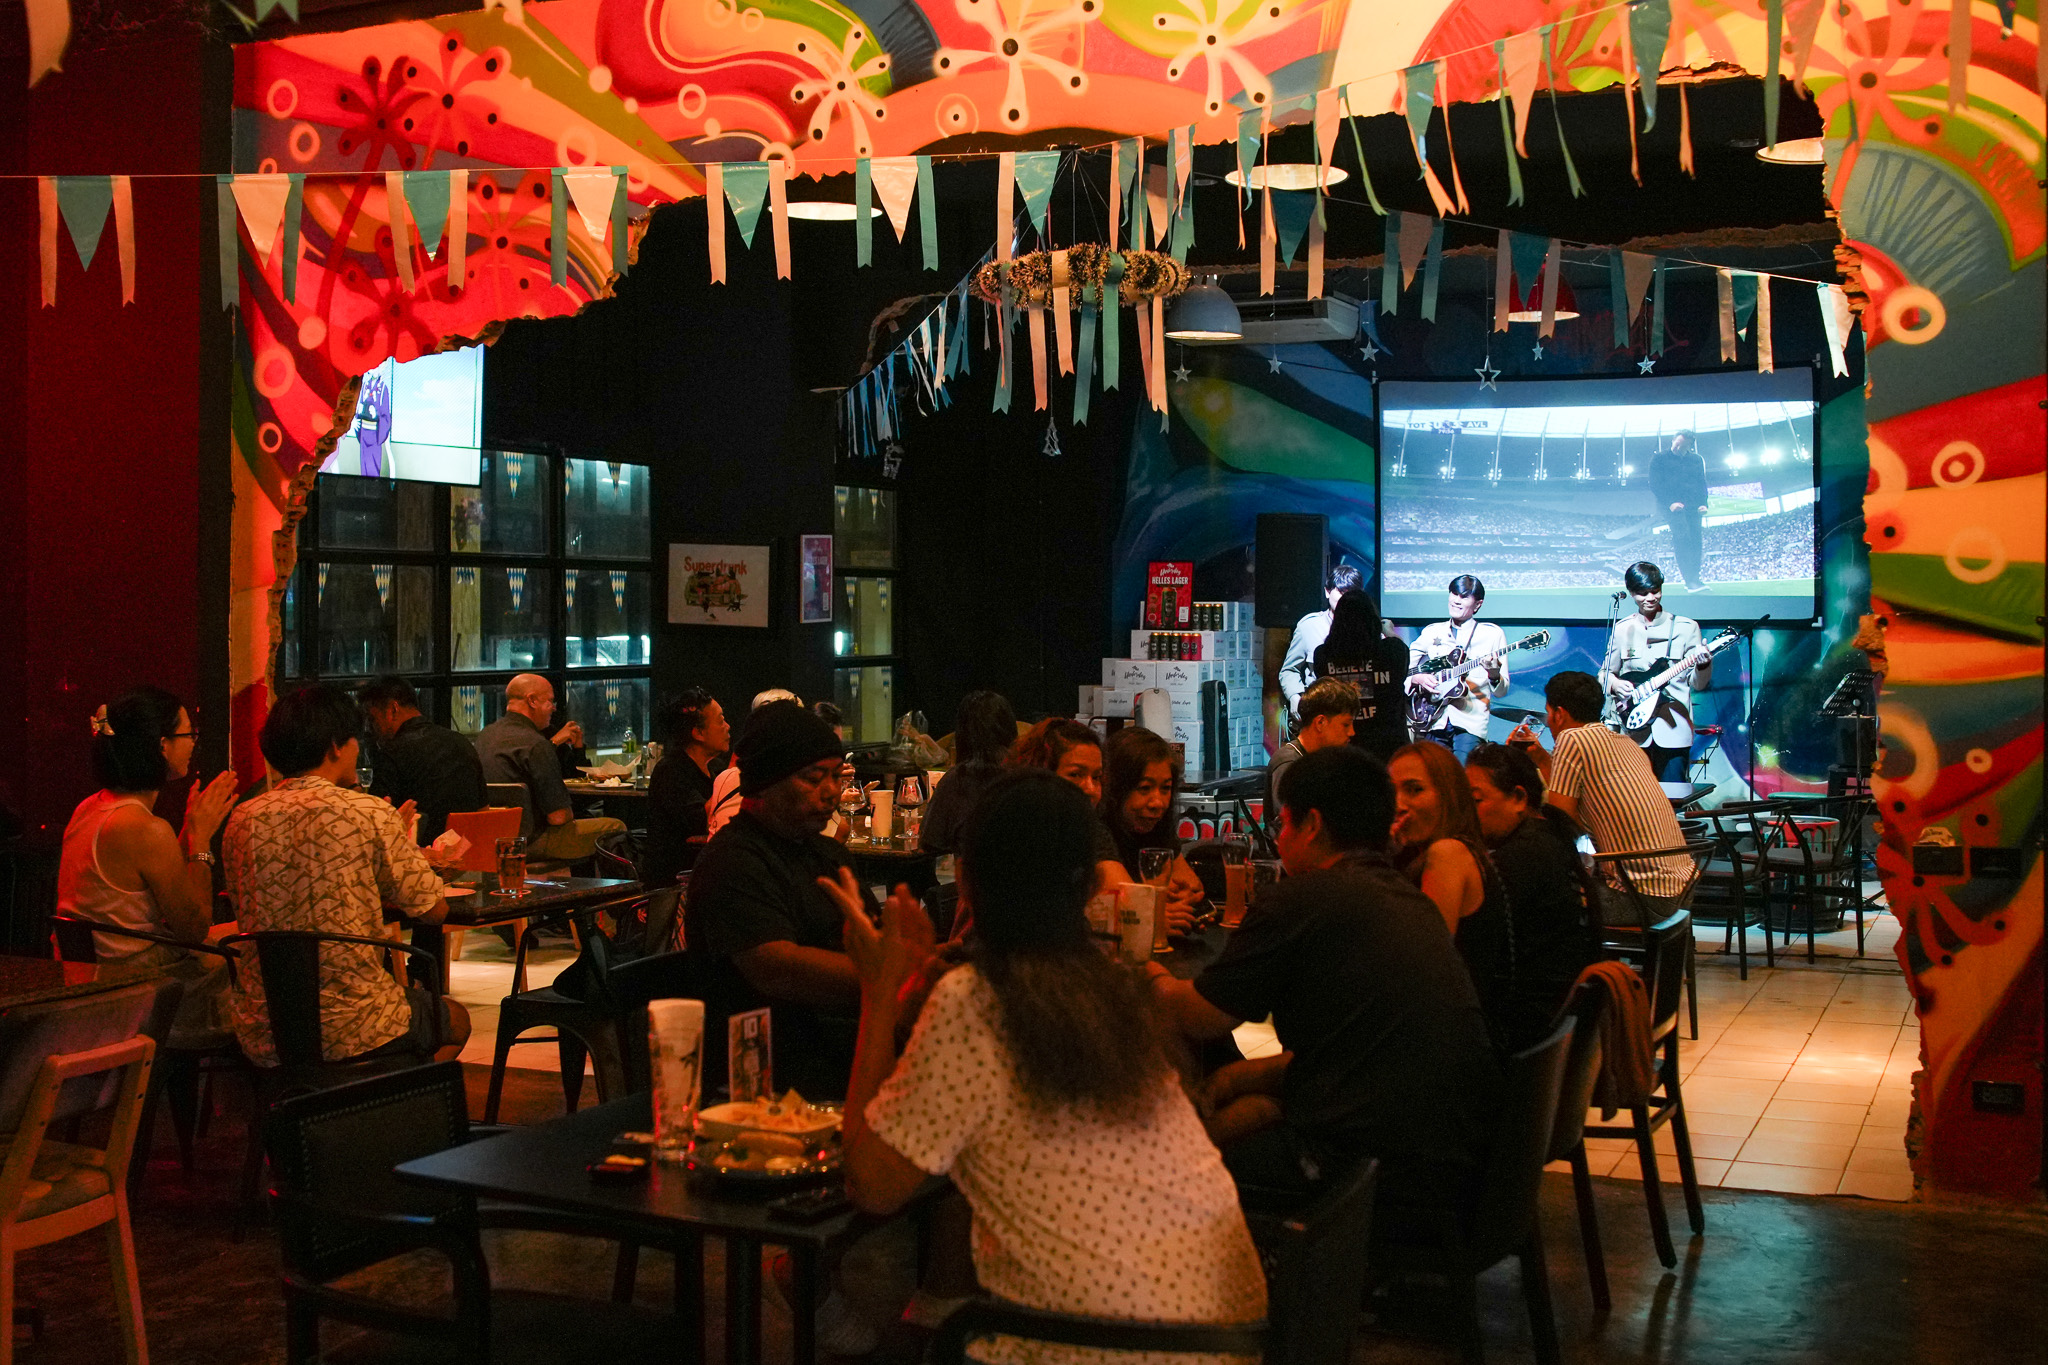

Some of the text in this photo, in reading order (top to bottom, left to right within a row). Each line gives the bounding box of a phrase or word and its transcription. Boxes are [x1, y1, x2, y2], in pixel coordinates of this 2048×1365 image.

[684, 556, 747, 576] Superdrunk
[1151, 576, 1189, 585] HELLES LAGER
[1374, 671, 1390, 684] IN
[1353, 706, 1377, 720] ELF
